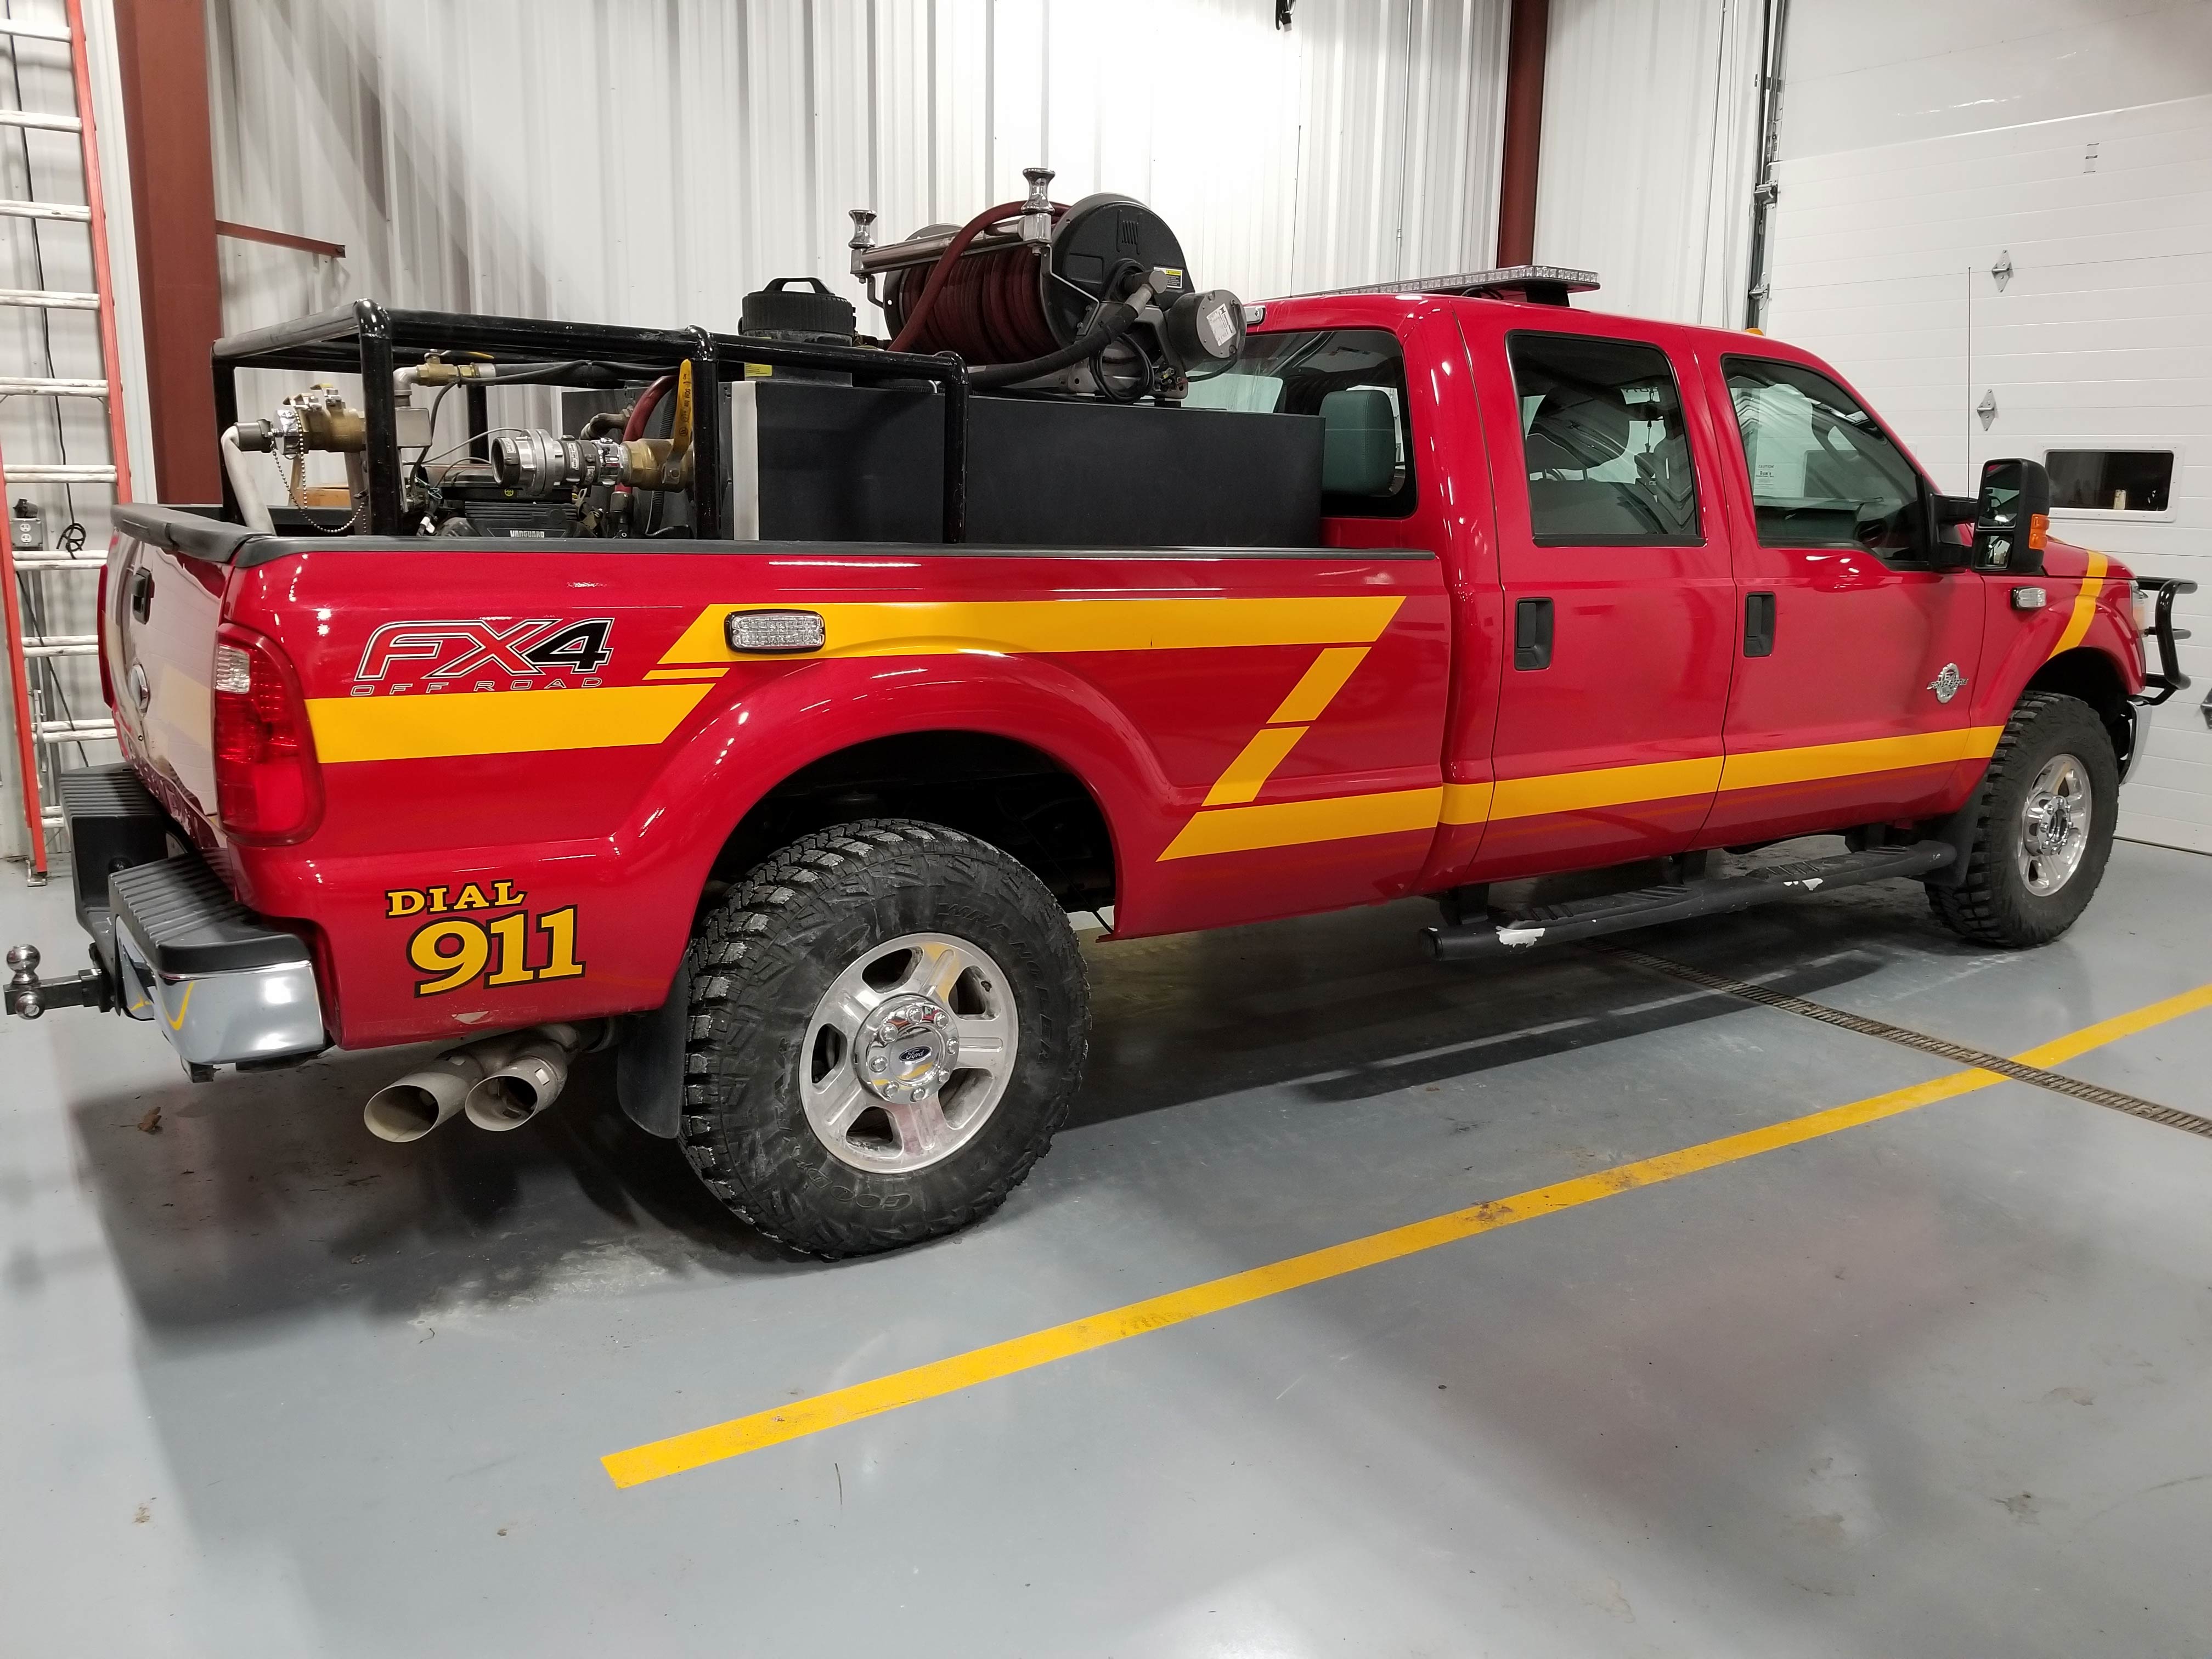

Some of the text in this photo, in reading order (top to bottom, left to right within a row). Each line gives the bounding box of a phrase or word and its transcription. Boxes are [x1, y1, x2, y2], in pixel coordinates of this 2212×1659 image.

[353, 618, 615, 681] FX4
[350, 678, 602, 696] OFF ROAD
[385, 879, 528, 919] DIAL
[406, 904, 586, 998] 911
[906, 1049, 925, 1060] Ford
